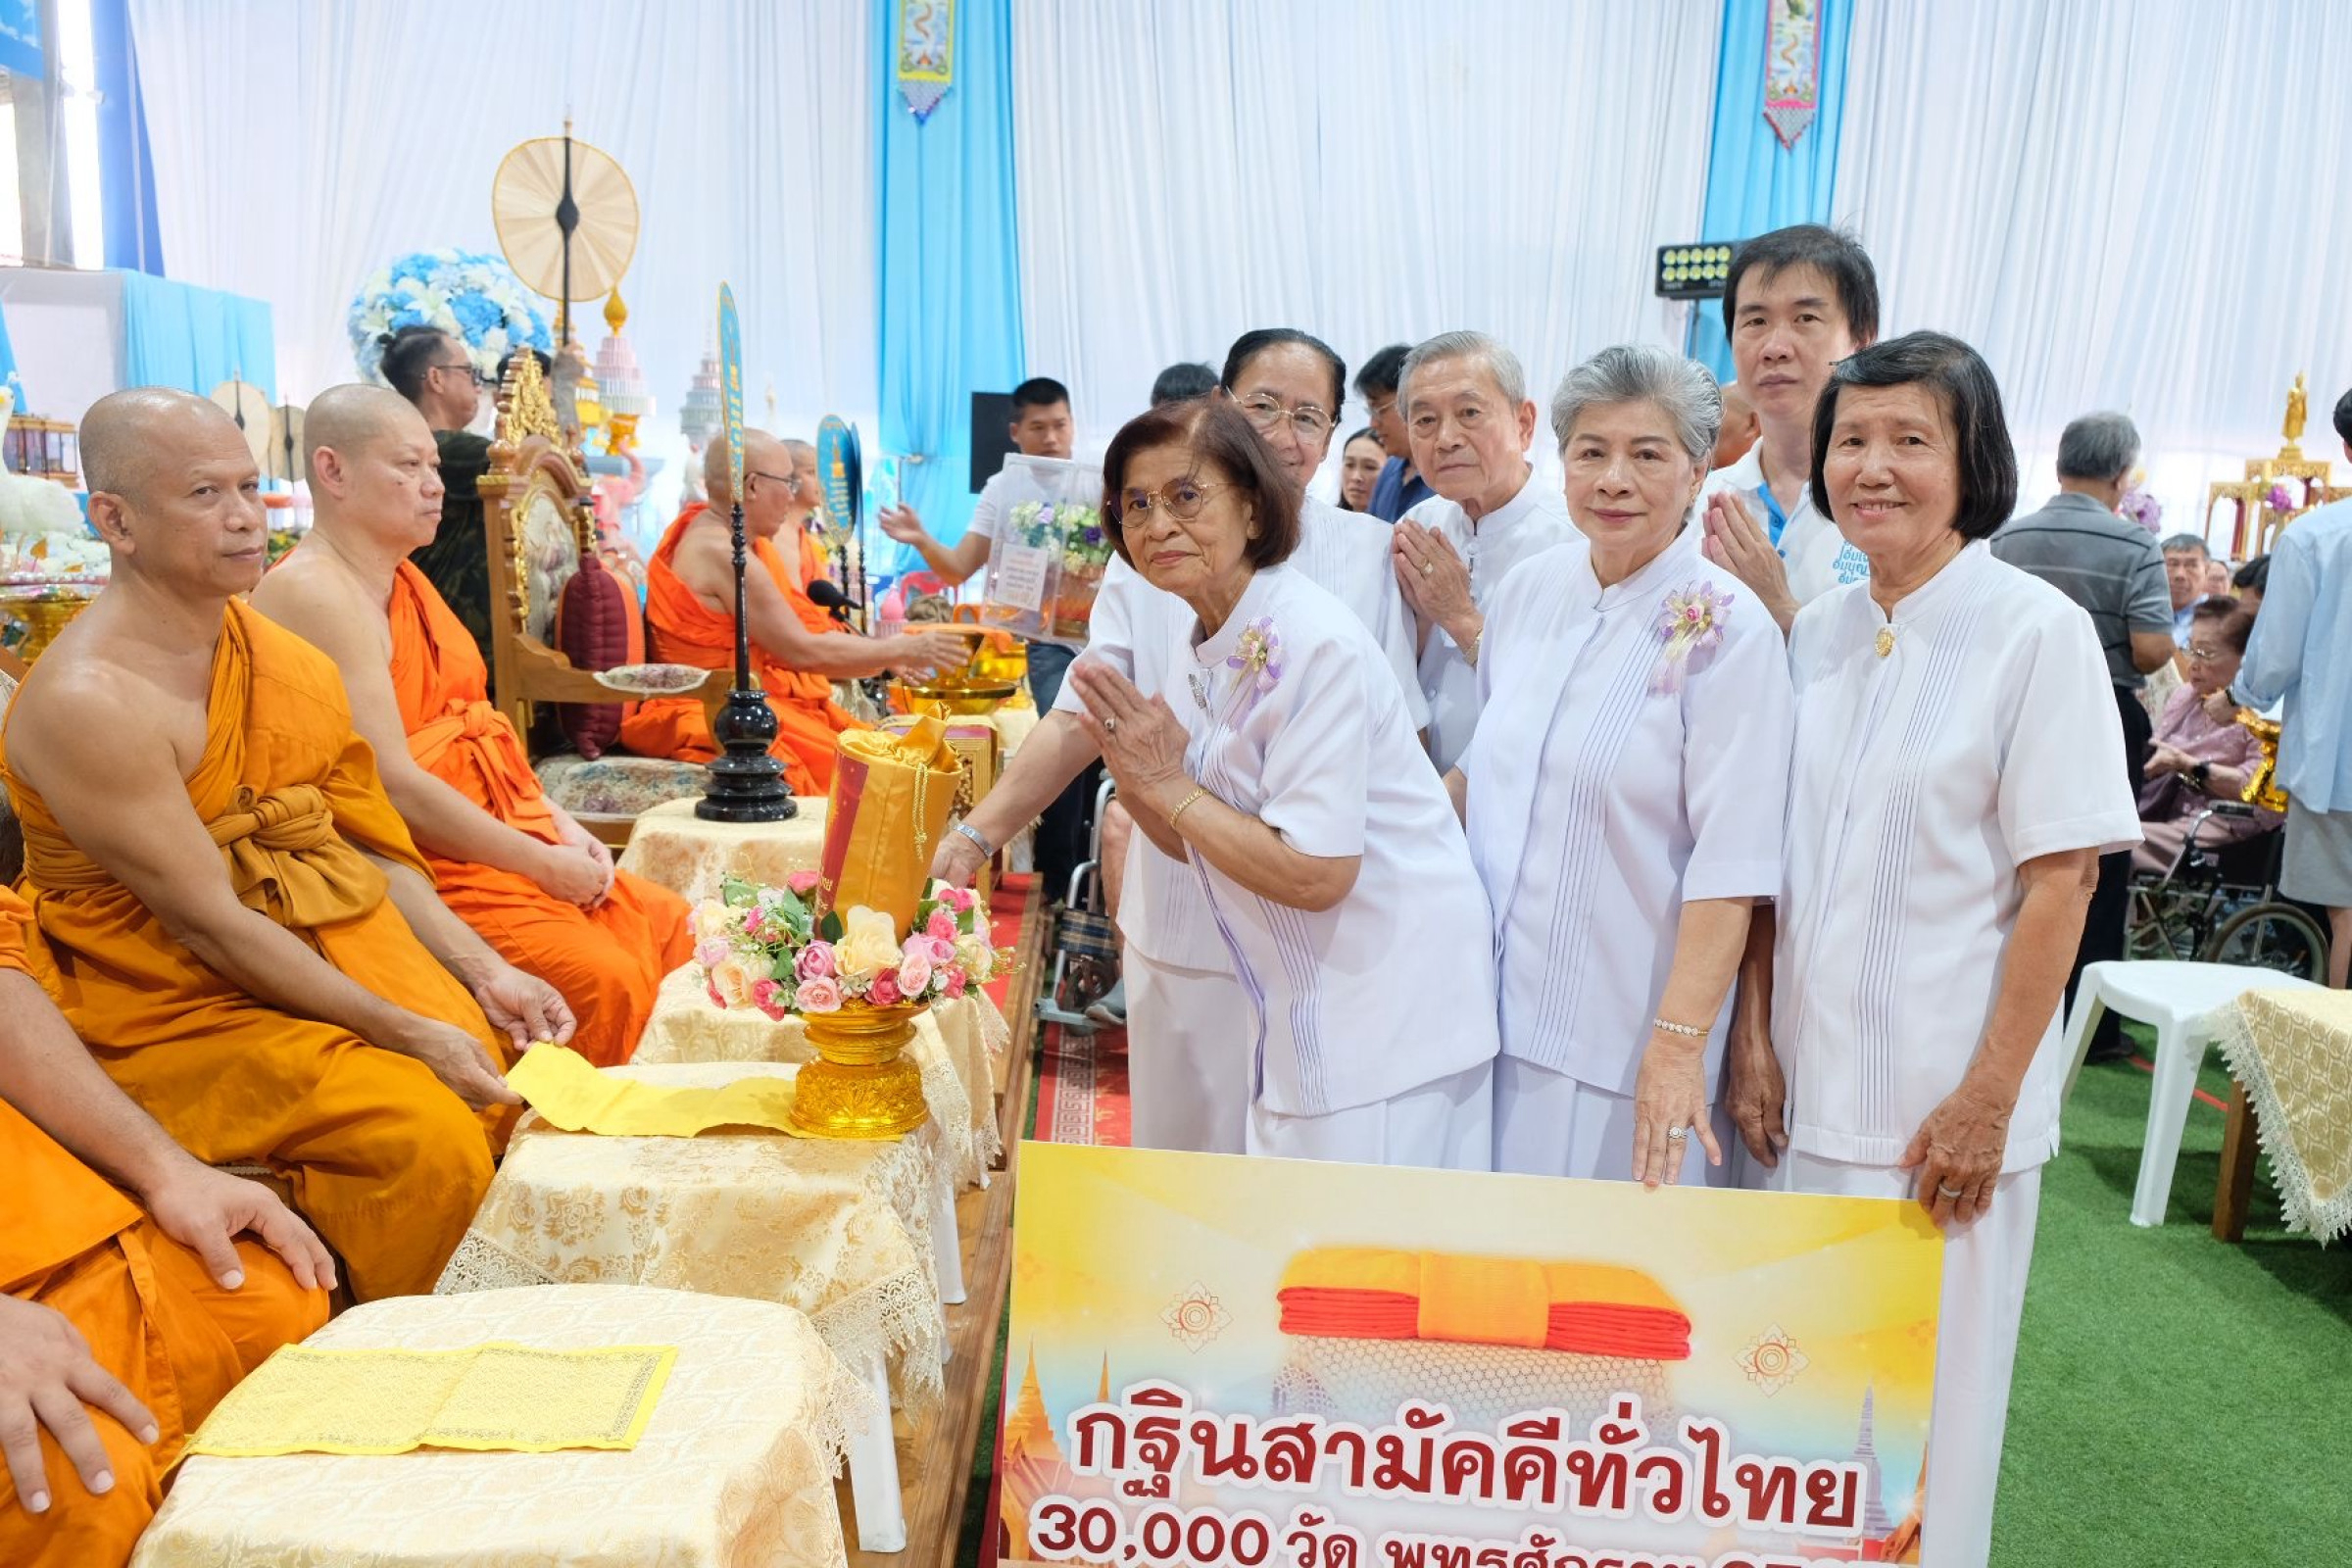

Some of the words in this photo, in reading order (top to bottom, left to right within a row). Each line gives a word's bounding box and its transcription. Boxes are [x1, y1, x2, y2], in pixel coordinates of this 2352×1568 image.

[1077, 1388, 1858, 1527] กฐินสามัคคีทั่วไทย
[1038, 1502, 1270, 1567] 30,000
[1287, 1512, 1358, 1568] วัด
